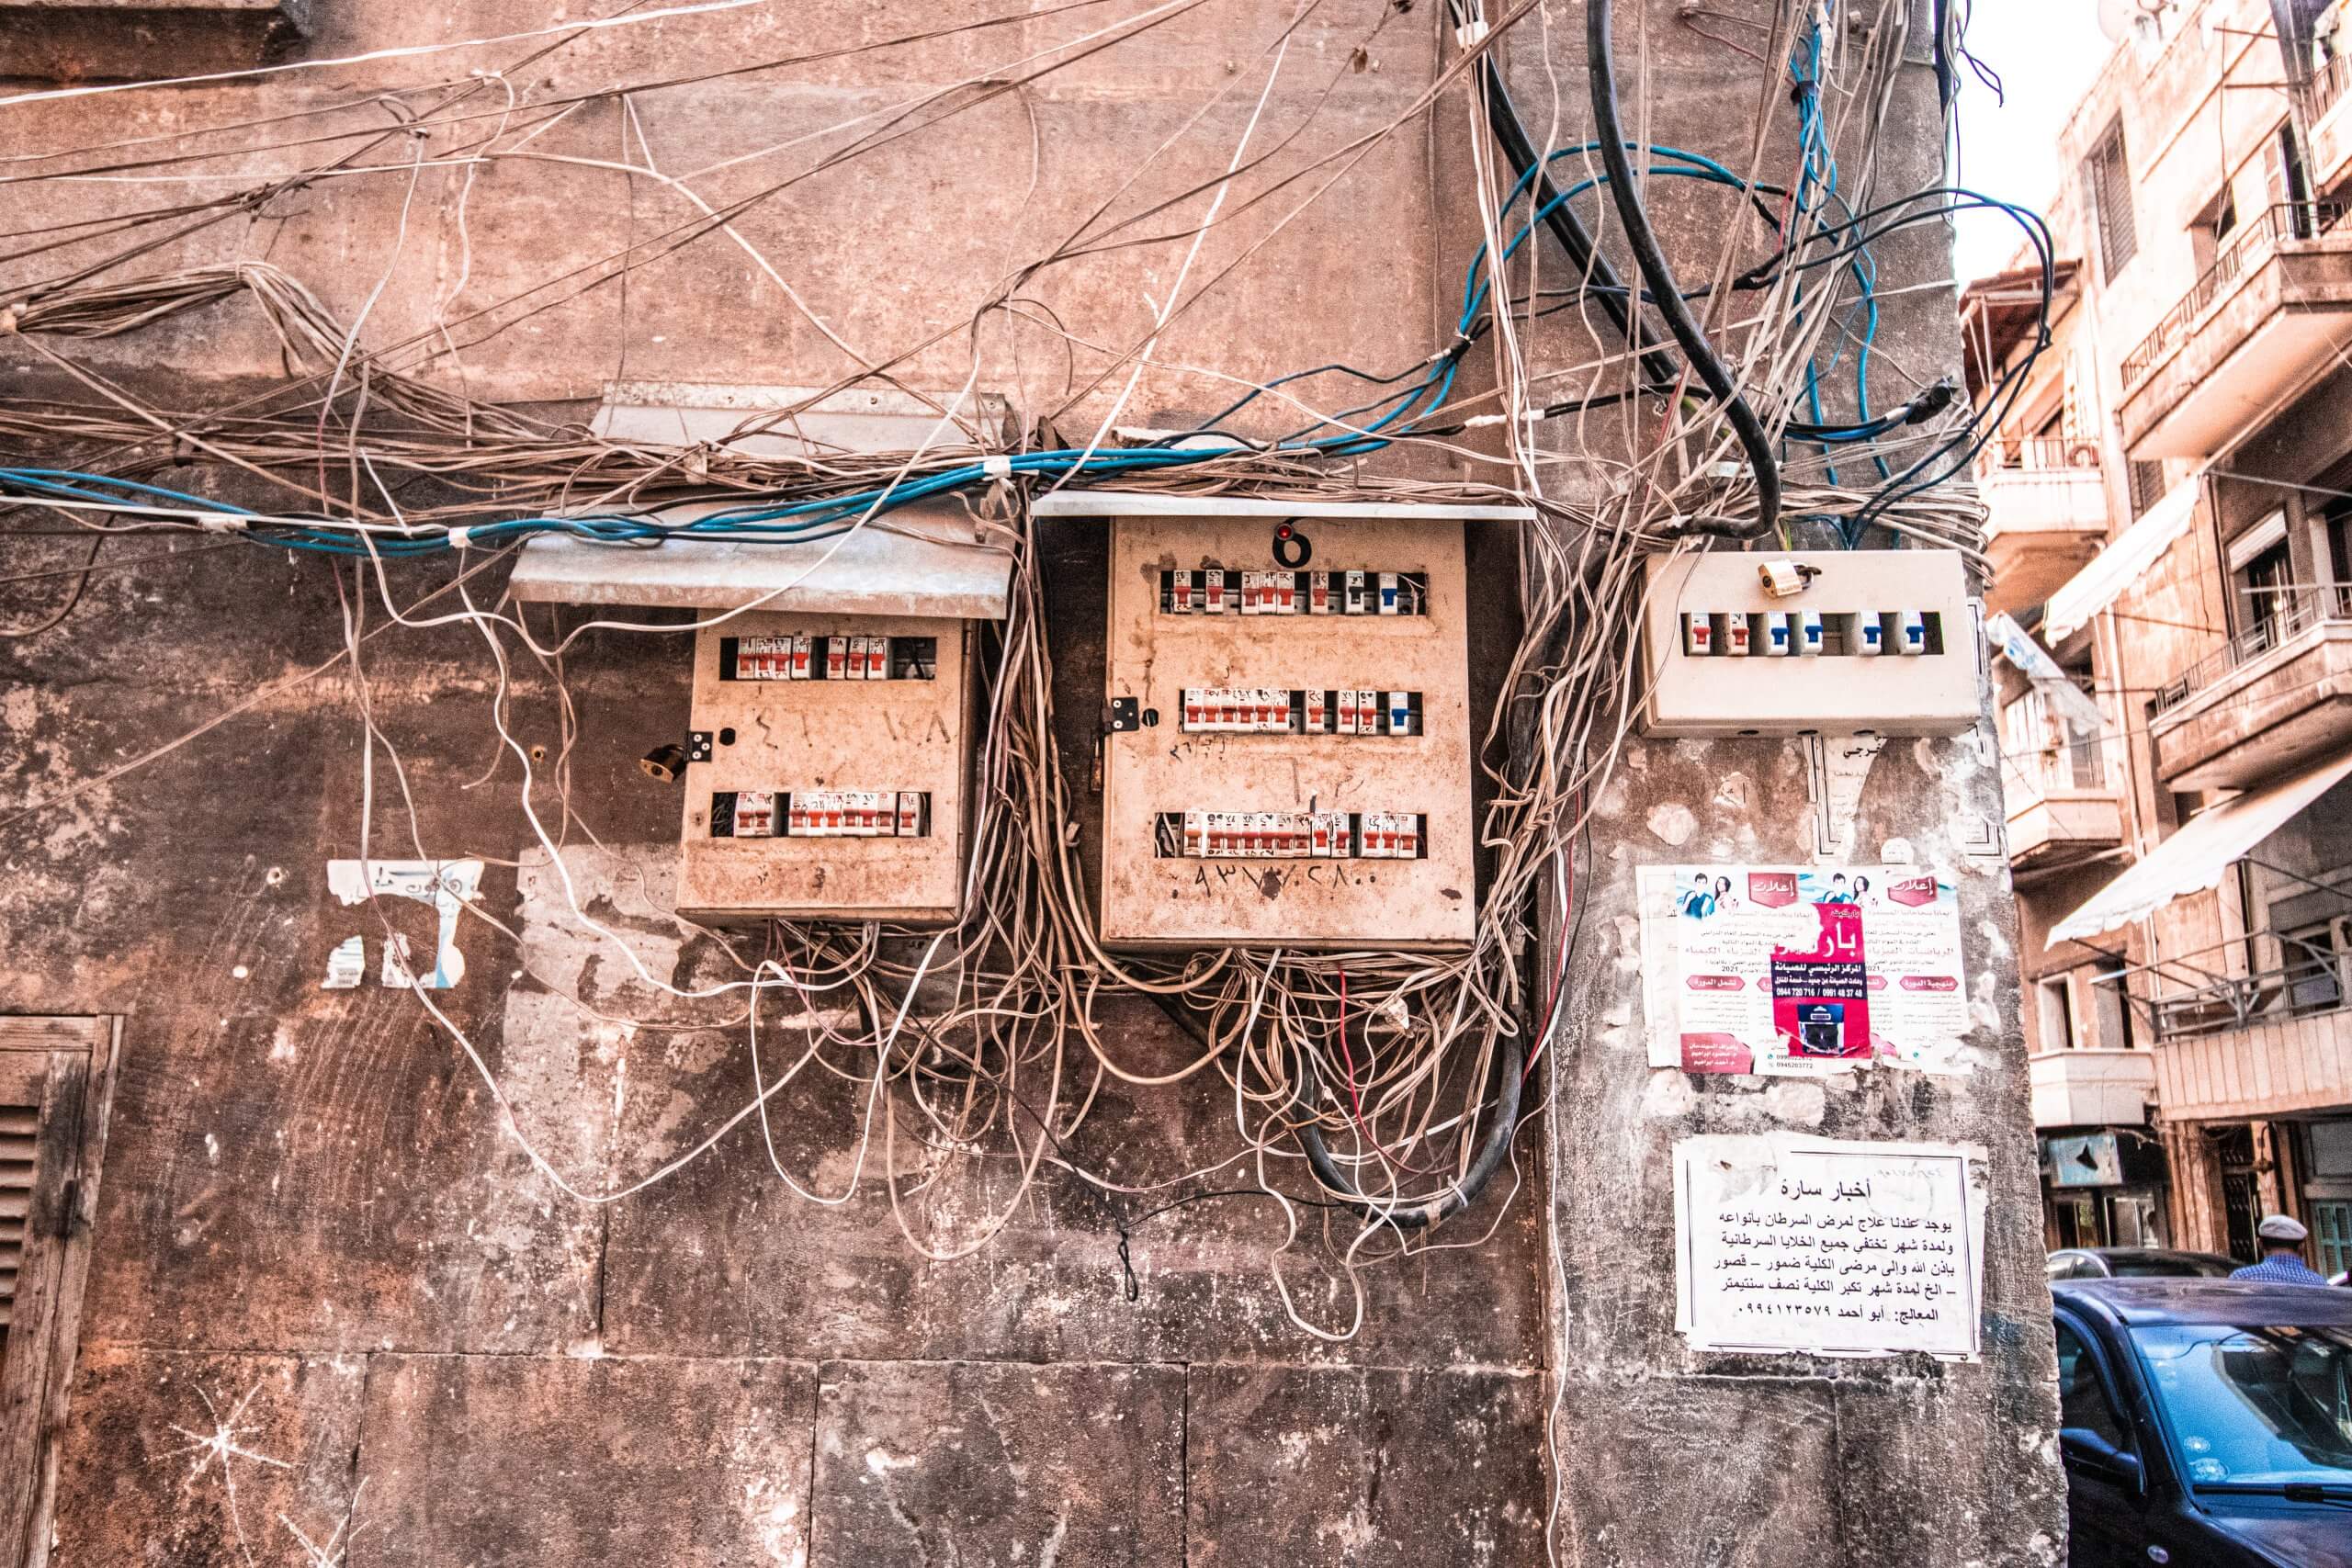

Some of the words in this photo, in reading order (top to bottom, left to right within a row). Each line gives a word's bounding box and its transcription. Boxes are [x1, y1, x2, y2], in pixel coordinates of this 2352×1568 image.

[1781, 1178, 1822, 1201] سارة
[1831, 1178, 1871, 1202] أخبار
[1764, 1212, 1812, 1228] السرطان
[1817, 1213, 1854, 1230] لمرض
[1858, 1215, 1885, 1233] علاج
[1891, 1217, 1919, 1229] عندنا
[1925, 1220, 1952, 1234] يوجد
[1721, 1230, 1776, 1248] السرطانية
[1781, 1235, 1815, 1250] الخلايا
[1820, 1238, 1849, 1254] جميع
[1853, 1236, 1888, 1255] تختفي
[1894, 1238, 1918, 1254] شهر
[1922, 1239, 1953, 1256] ولمدة
[1713, 1253, 1747, 1269] قصور
[1765, 1257, 1801, 1271] ضمور
[1804, 1255, 1835, 1272] الكلية
[1839, 1258, 1877, 1276] مرضى
[1882, 1259, 1907, 1277] وإلى
[1911, 1258, 1926, 1273] الله
[1721, 1277, 1765, 1292] سنتيمتر
[1768, 1278, 1800, 1291] نصف
[1804, 1277, 1835, 1294] الكلية
[1839, 1281, 1862, 1296] تكبر
[1867, 1280, 1893, 1297] شهر
[1896, 1281, 1920, 1296] لمدة
[1924, 1282, 1942, 1301] الخ
[1738, 1302, 1831, 1316] ٠٩٩٤١٢٣٥٧٩
[1838, 1303, 1863, 1318] أحمد
[1868, 1303, 1884, 1322] أبو
[1894, 1308, 1939, 1325] المعالج:
